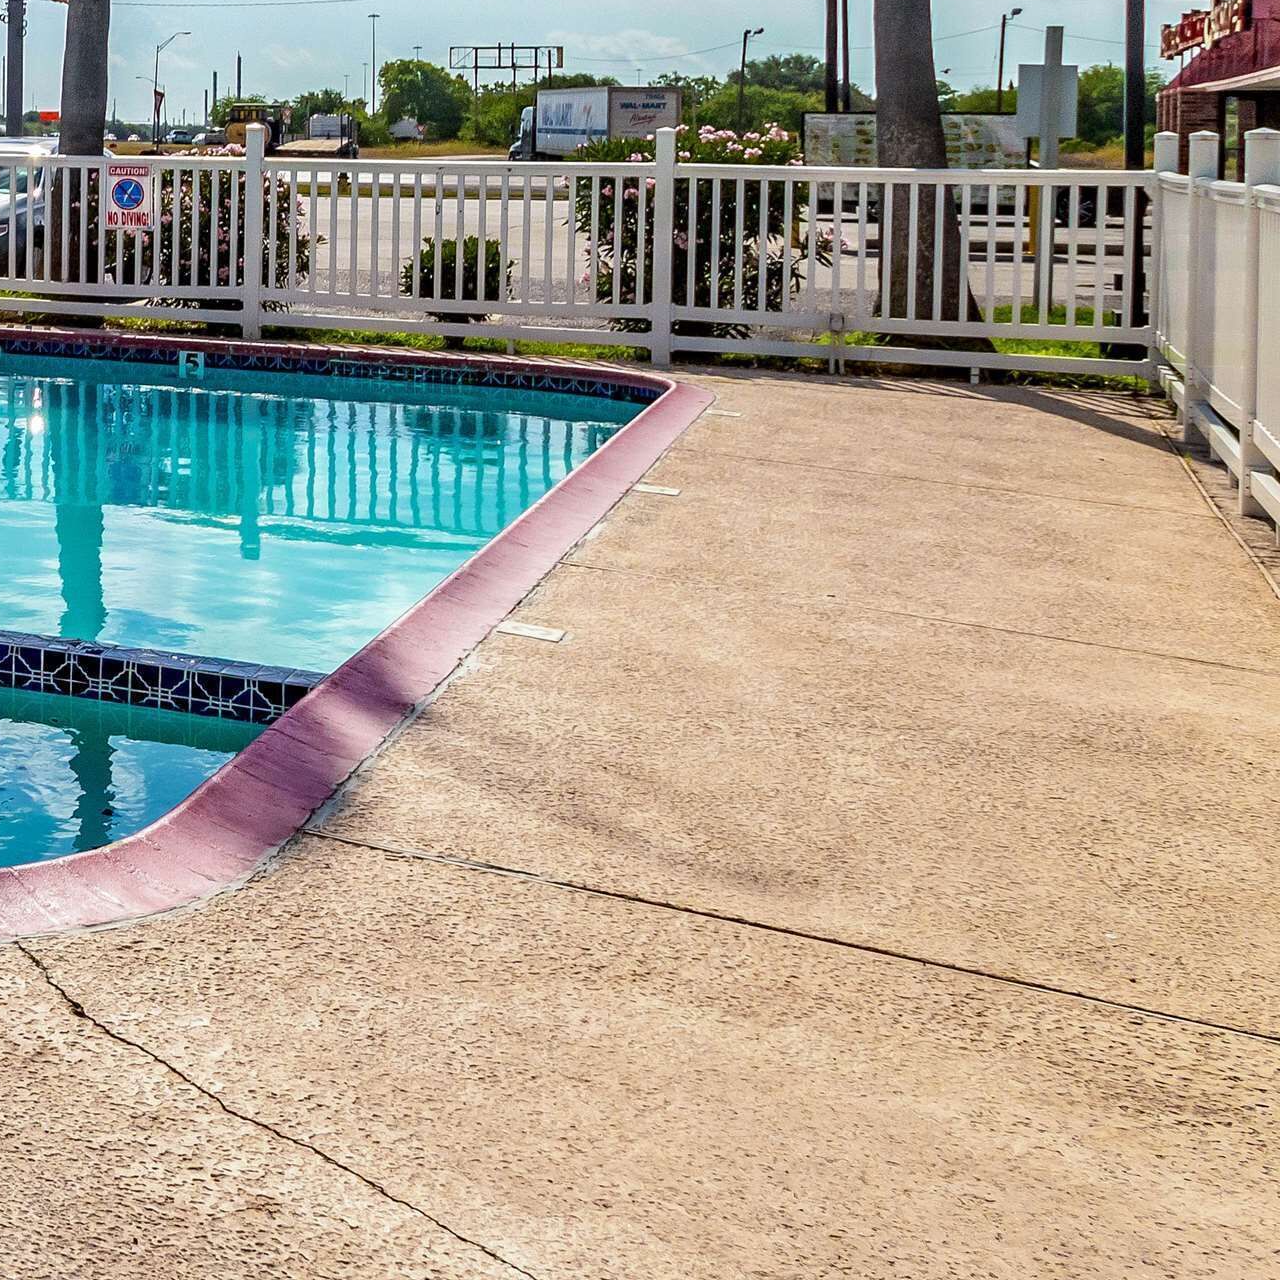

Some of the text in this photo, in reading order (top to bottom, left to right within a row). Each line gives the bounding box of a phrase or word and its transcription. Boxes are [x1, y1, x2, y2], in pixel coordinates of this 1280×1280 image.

[110, 167, 148, 175] CAUTION!
[107, 211, 150, 226] NO DIVING!
[185, 352, 200, 374] 5
